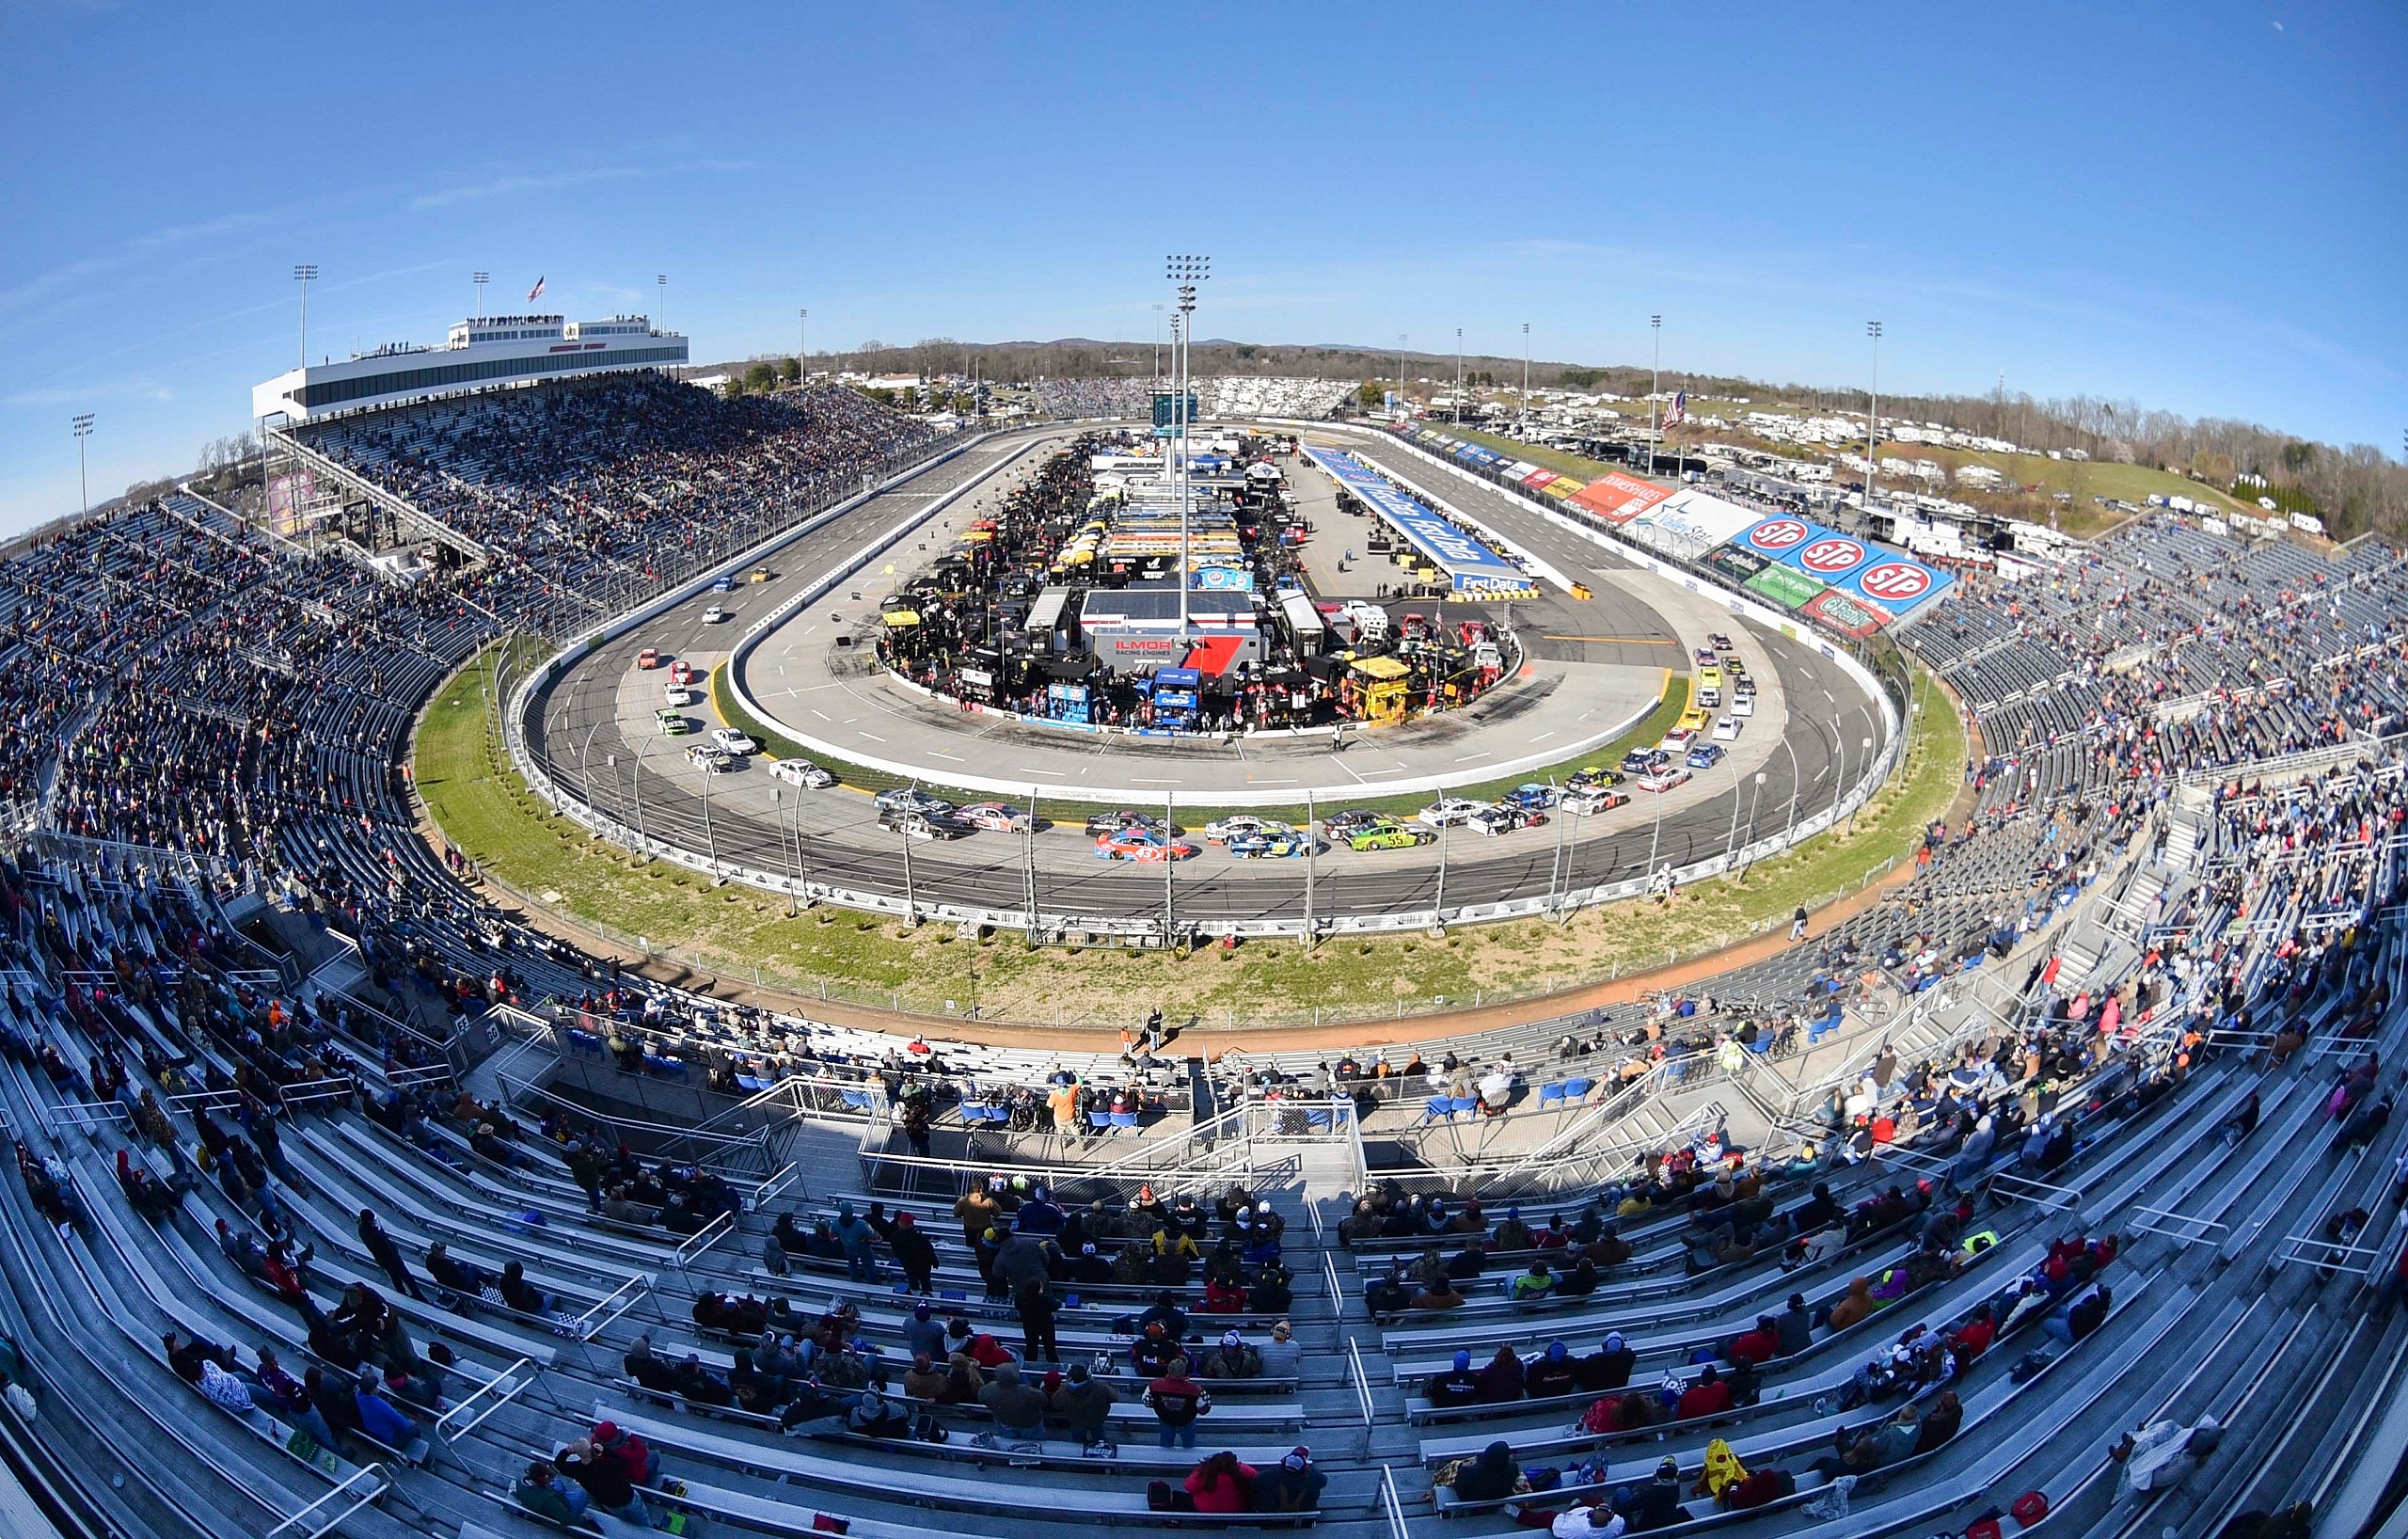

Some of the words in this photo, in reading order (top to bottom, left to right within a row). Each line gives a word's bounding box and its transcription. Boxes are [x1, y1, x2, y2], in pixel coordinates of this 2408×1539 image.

[1402, 517, 1455, 537] First
[1755, 522, 1801, 544] STP
[1424, 536, 1482, 561] Data
[1806, 543, 1857, 566] STP
[1463, 577, 1489, 590] First
[1490, 578, 1519, 590] Data
[1865, 566, 1923, 594] STP
[1116, 641, 1171, 649] ILMOR
[1386, 834, 1404, 846] 55
[1135, 848, 1151, 858] 43
